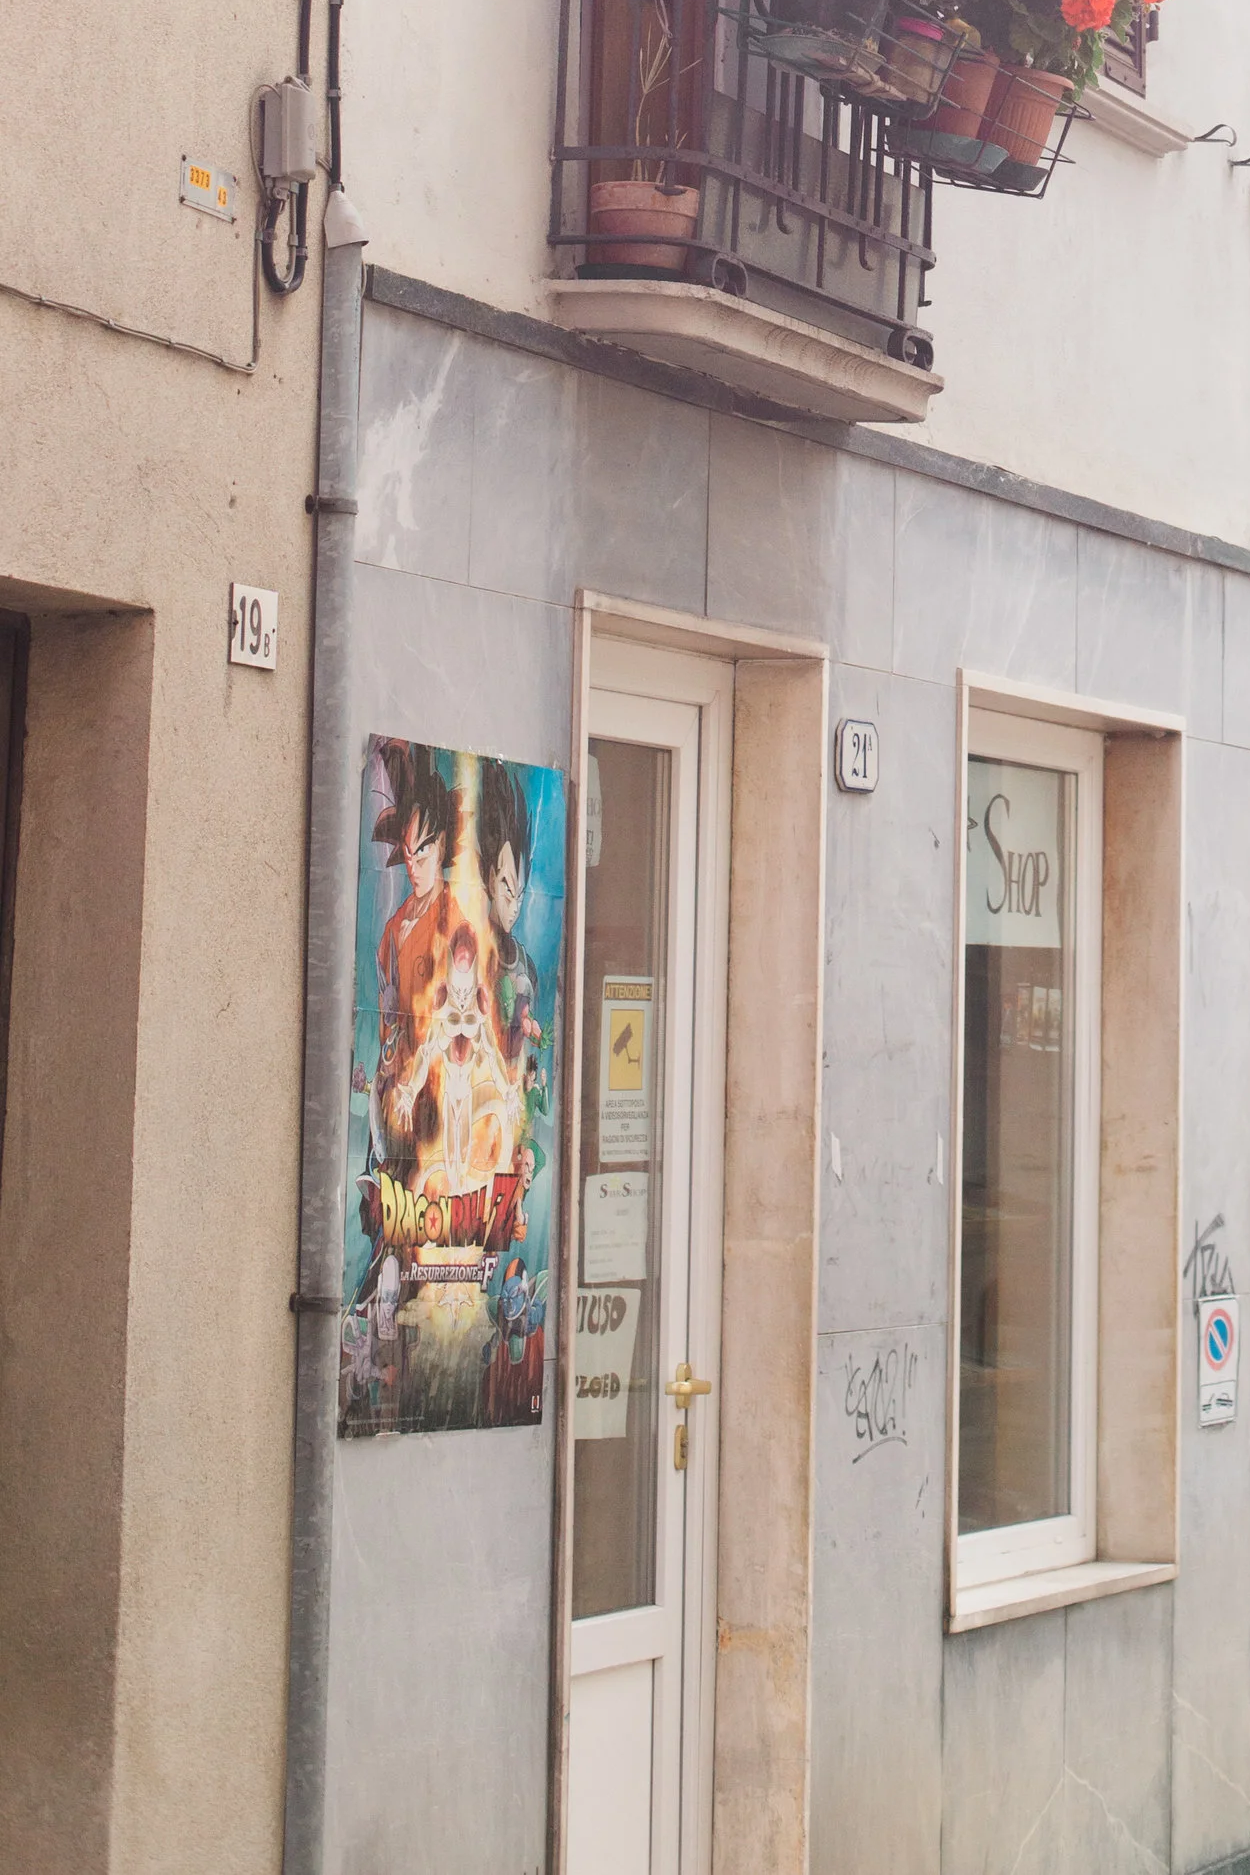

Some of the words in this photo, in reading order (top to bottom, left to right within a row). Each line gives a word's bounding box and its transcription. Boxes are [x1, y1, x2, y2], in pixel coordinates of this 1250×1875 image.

[190, 167, 210, 188] 3373
[217, 189, 227, 205] 43
[576, 1294, 627, 1336] IUSO
